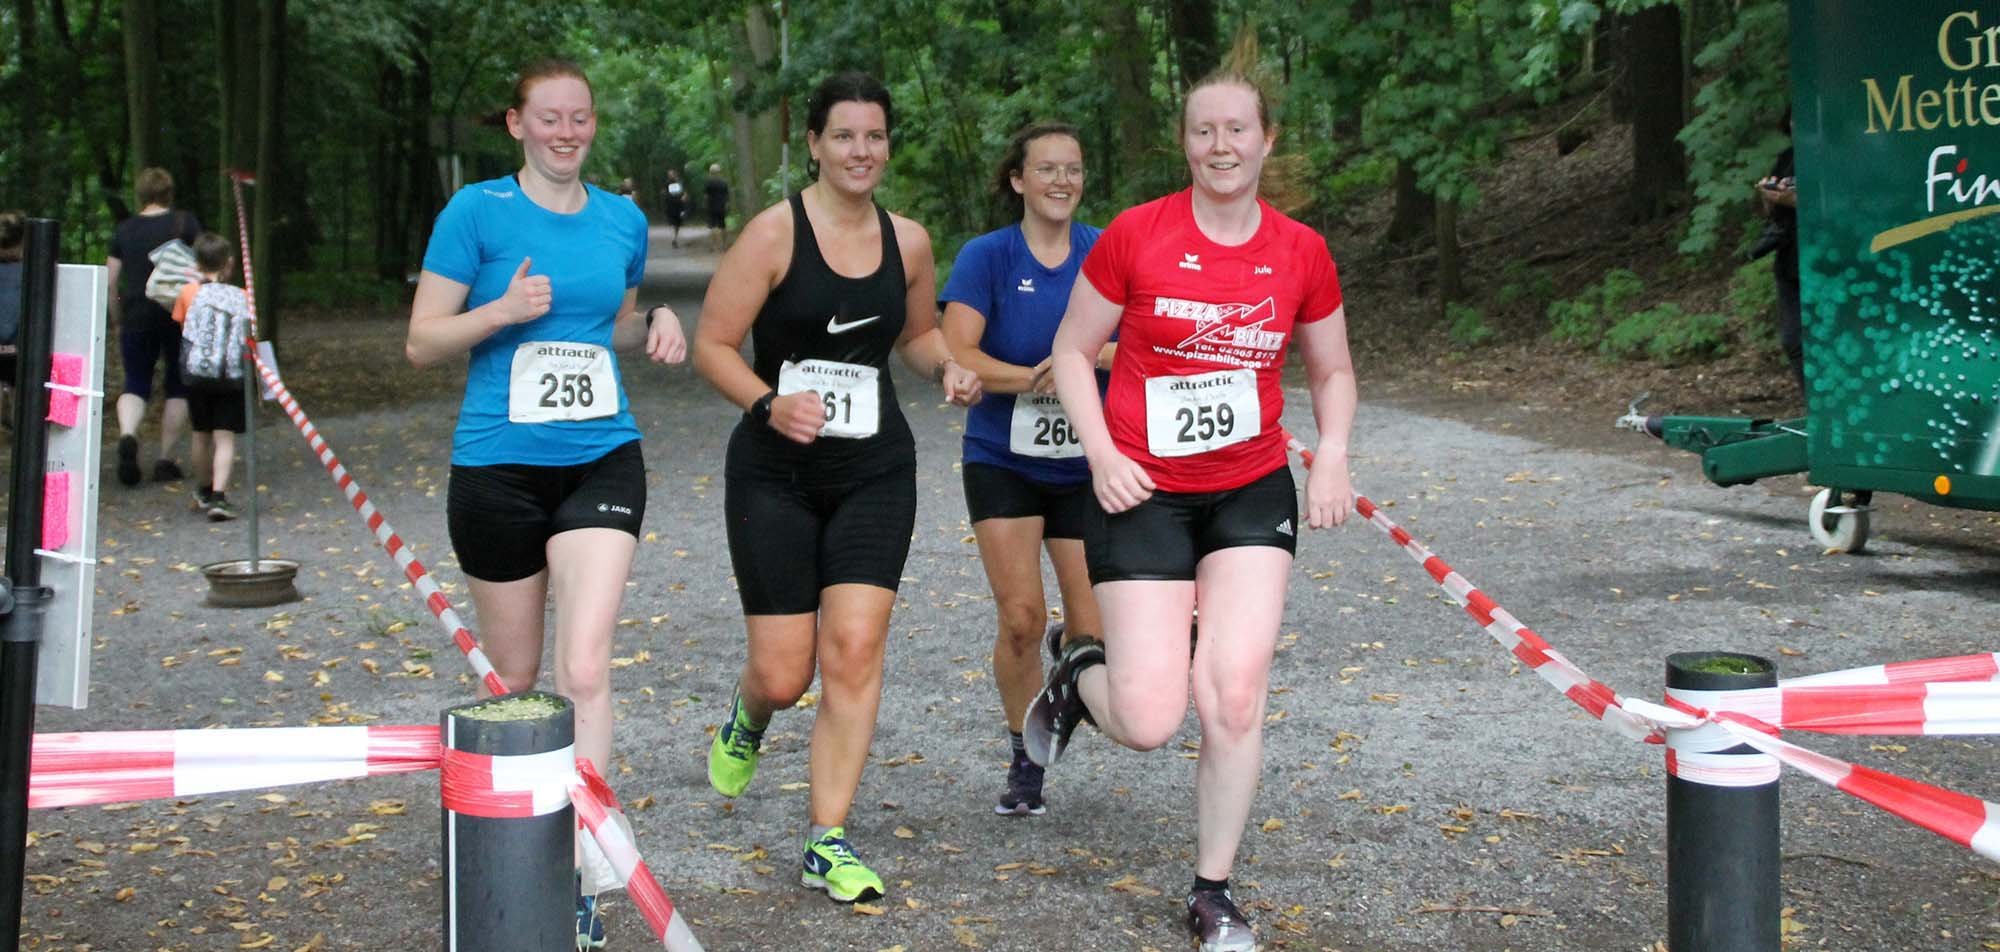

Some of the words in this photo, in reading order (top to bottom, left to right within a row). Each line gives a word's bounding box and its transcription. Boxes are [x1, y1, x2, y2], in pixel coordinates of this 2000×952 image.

[1861, 75, 2000, 134] Mette
[1154, 297, 1222, 323] PIZZA
[1232, 326, 1286, 350] BLITZ
[539, 373, 594, 407] 258
[1170, 375, 1234, 390] attractic
[808, 390, 851, 424] 61
[1175, 403, 1234, 443] 259
